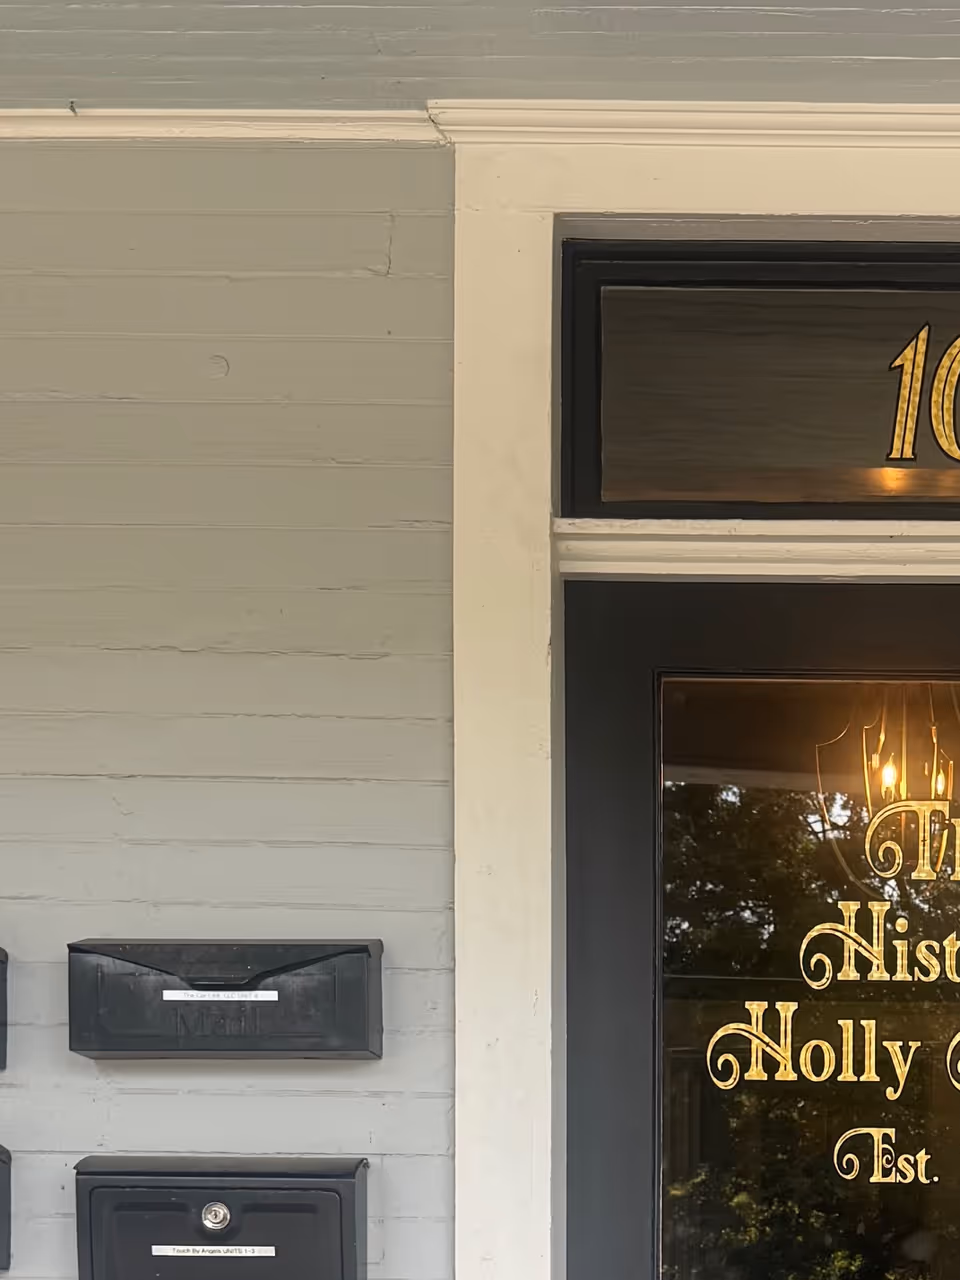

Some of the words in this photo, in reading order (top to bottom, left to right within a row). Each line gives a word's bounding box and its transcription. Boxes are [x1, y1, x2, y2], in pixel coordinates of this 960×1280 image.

[174, 1007, 261, 1036] Mail
[706, 1001, 921, 1101] Holly
[833, 1126, 939, 1184] Est.
